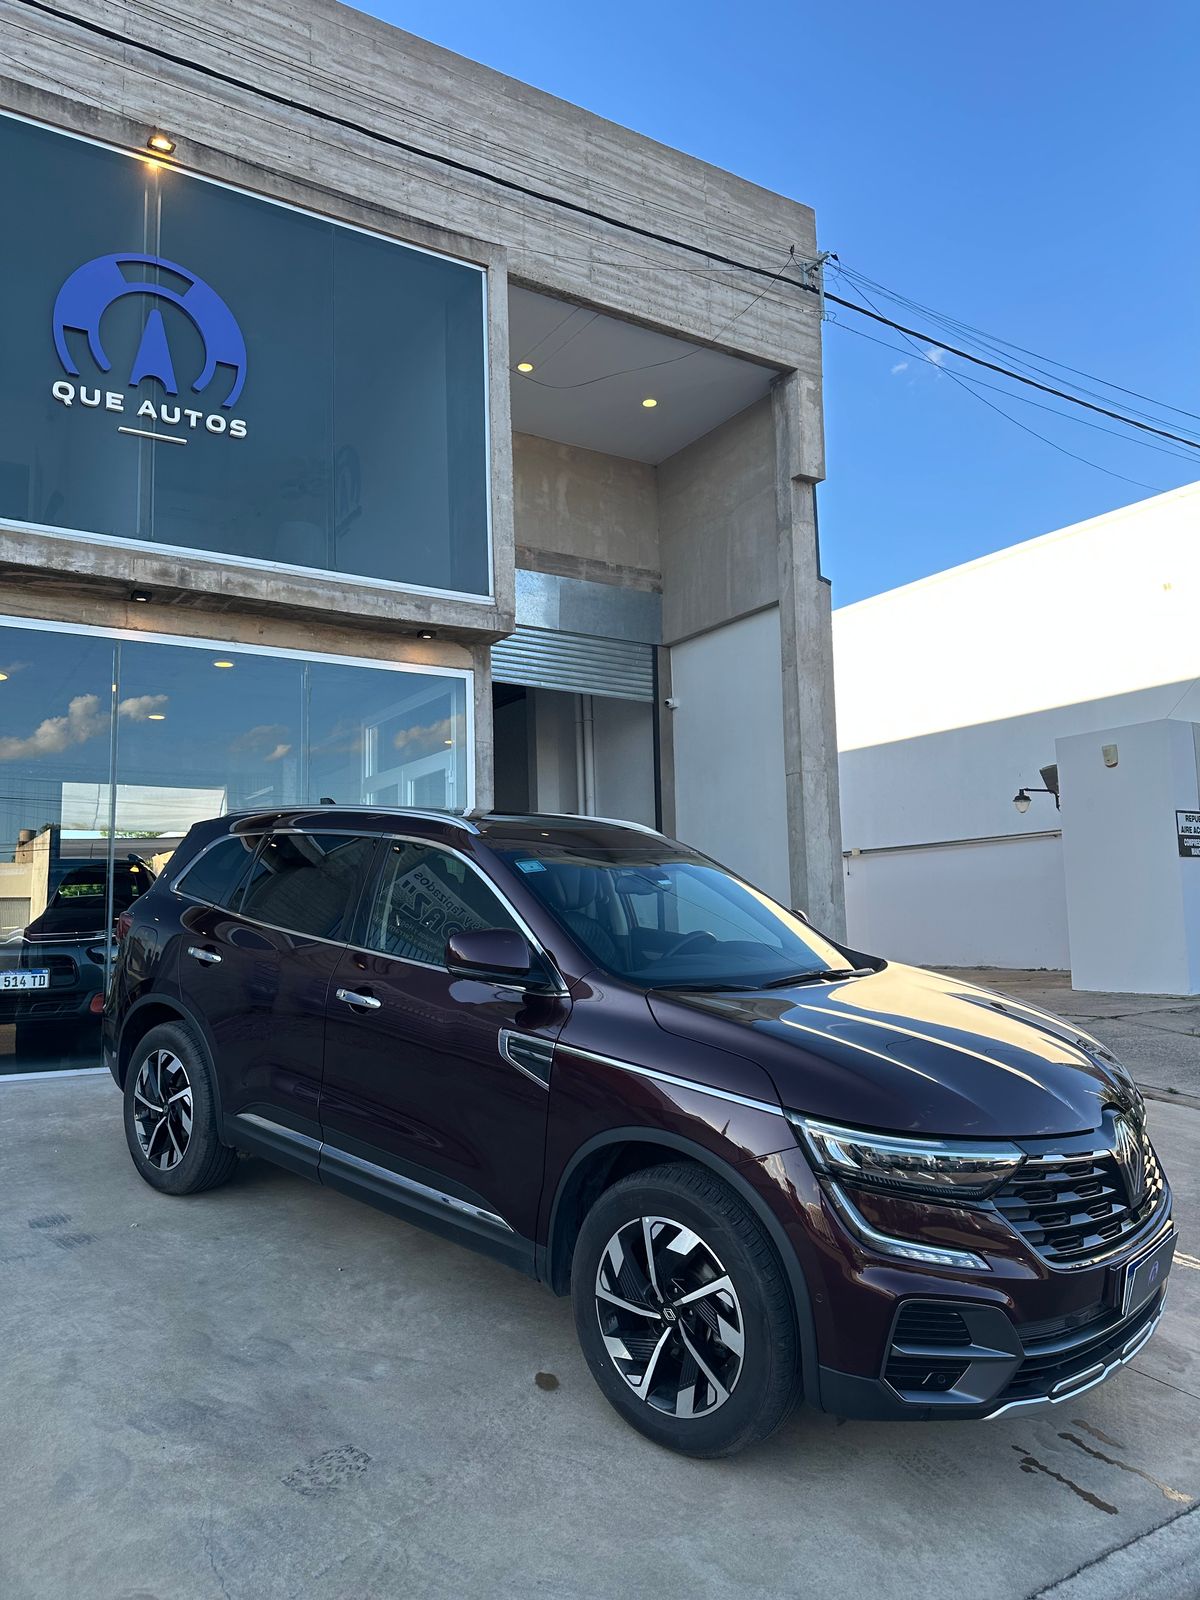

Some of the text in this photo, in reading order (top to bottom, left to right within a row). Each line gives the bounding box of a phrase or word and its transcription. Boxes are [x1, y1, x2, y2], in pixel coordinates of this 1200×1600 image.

[52, 381, 247, 439] QUE AUTOS
[1181, 825, 1192, 834] AIRE
[4, 975, 45, 987] 514 TD
